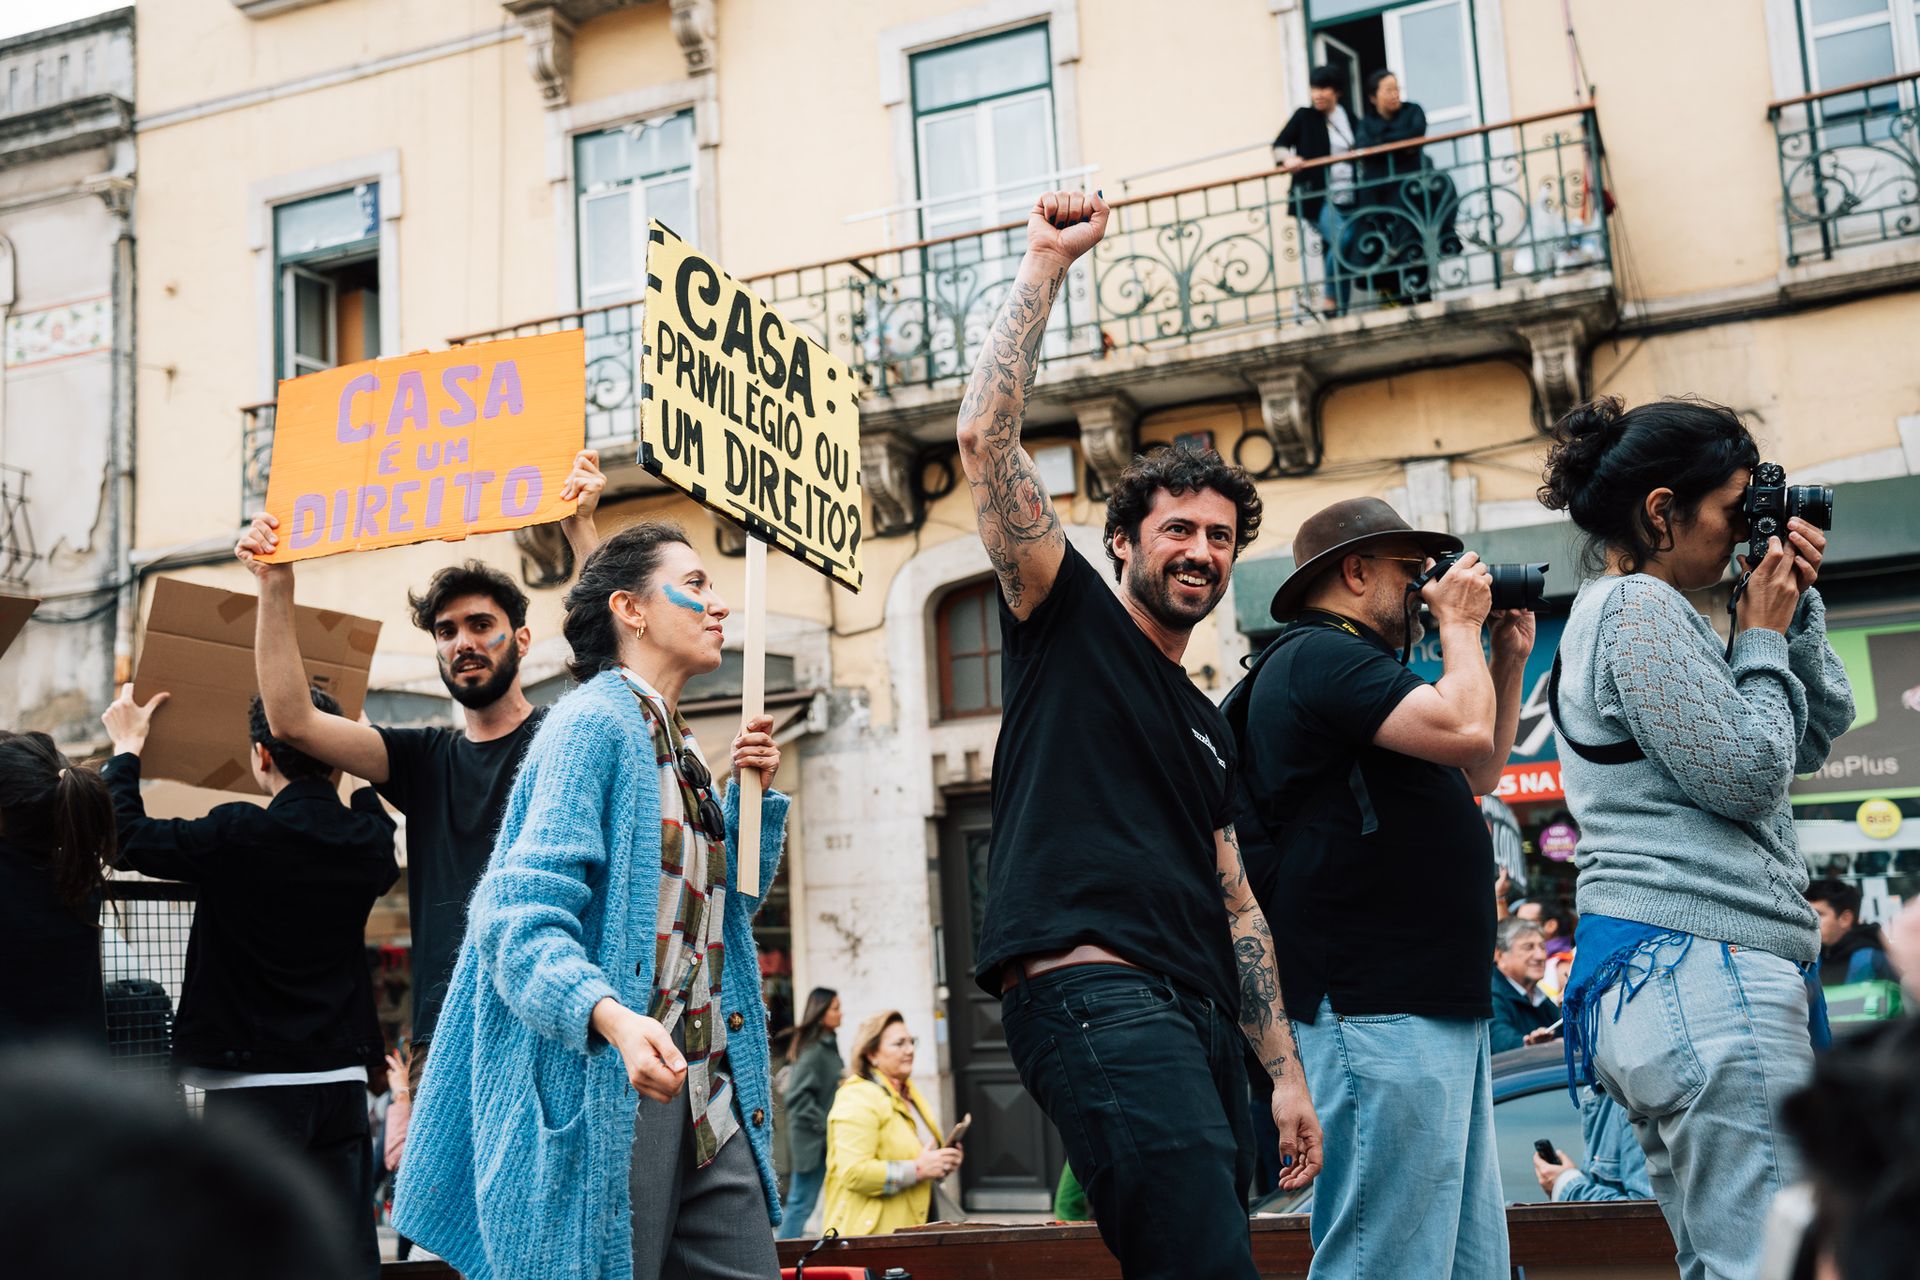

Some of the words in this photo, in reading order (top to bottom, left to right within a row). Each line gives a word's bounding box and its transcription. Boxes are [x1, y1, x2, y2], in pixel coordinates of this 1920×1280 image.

[336, 360, 525, 444] CASA
[656, 320, 802, 460] PRIVILÉGIO
[815, 431, 850, 493] OU
[378, 440, 401, 475] É
[416, 437, 470, 472] UM
[661, 399, 705, 476] UM
[724, 429, 862, 568] DIREITO?
[288, 465, 544, 550] DIREITO
[1520, 770, 1557, 794] NA
